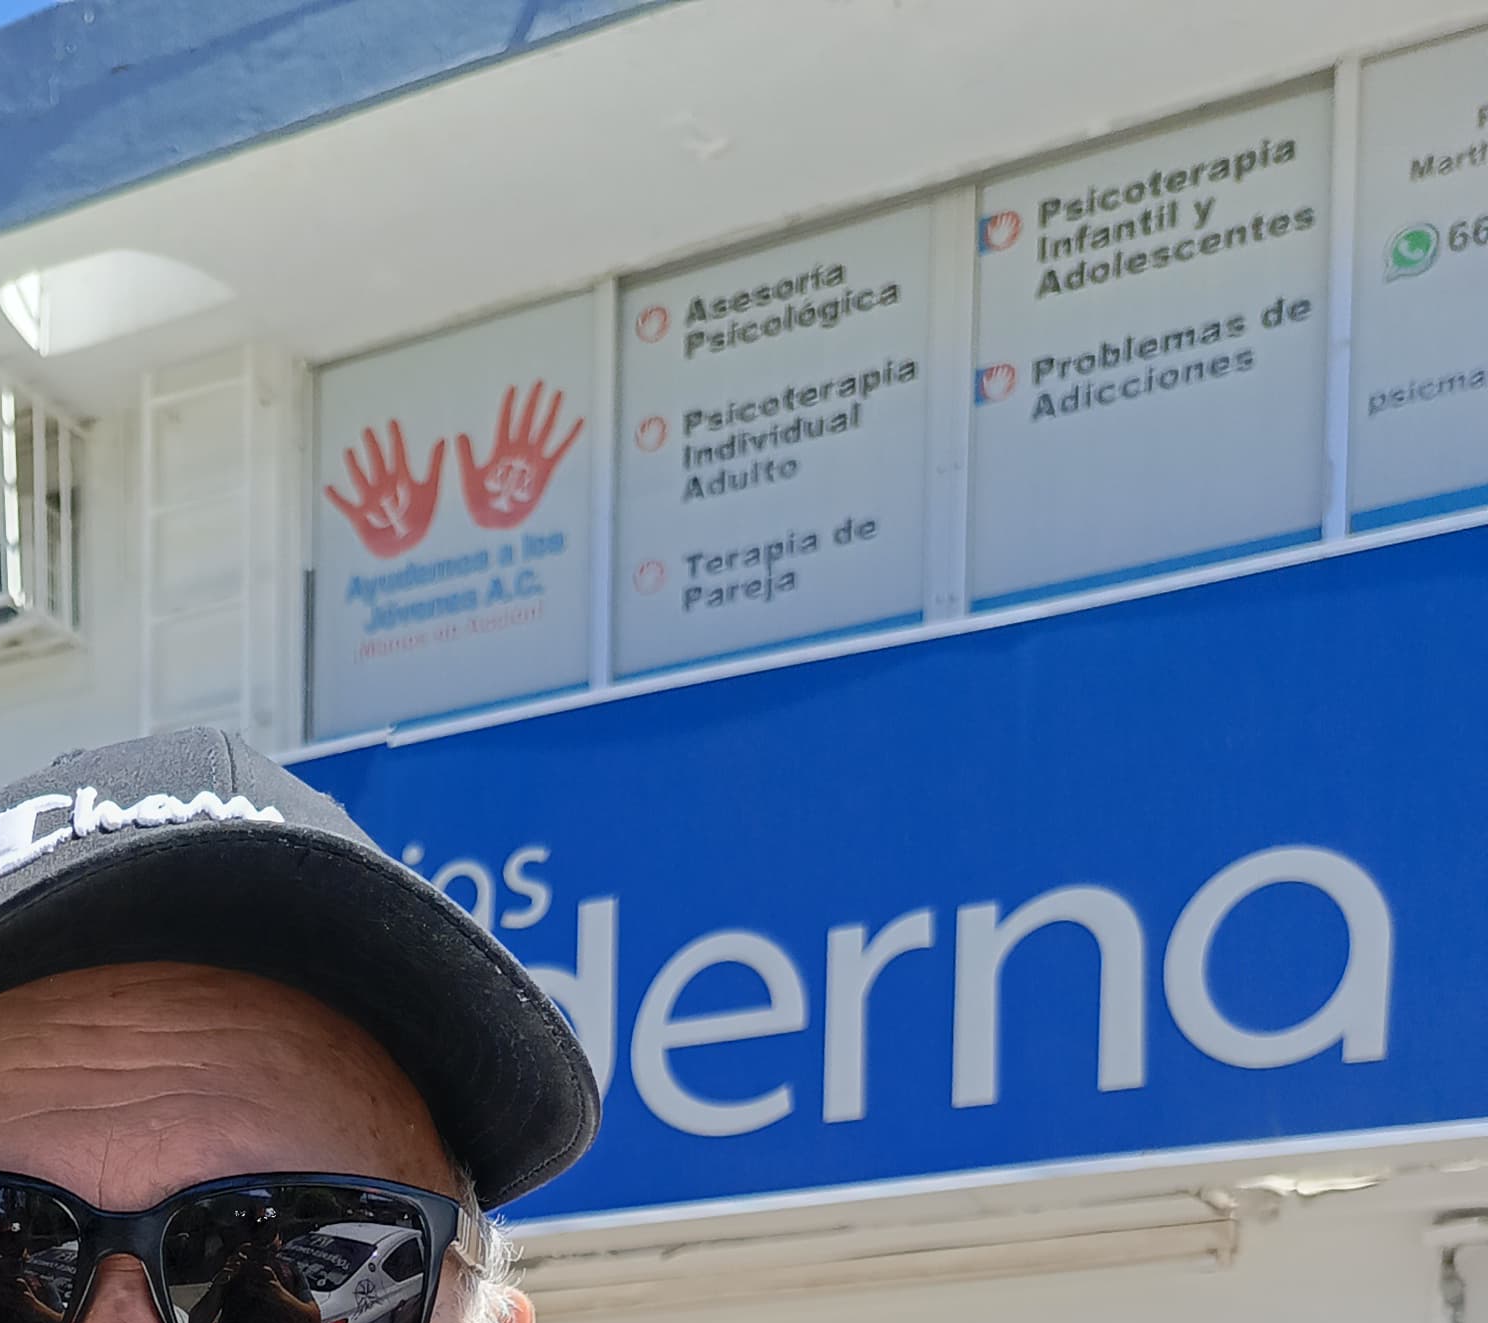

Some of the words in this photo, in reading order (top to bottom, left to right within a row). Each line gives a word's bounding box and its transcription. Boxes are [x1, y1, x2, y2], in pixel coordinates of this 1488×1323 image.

[1037, 136, 1297, 229] Psicoterapia
[1035, 206, 1317, 299] Adolescentes
[1037, 203, 1178, 262] Infantil
[1193, 196, 1216, 230] y
[1448, 215, 1488, 252] 66
[683, 281, 901, 360] Psicológica
[684, 262, 848, 327] Asesoría
[1030, 311, 1246, 385] Problemas
[1260, 296, 1312, 331] de
[683, 358, 920, 437] Psicoterapia
[1029, 347, 1256, 422] Adicciones
[1367, 368, 1488, 418] psicma
[682, 400, 862, 470] Individual
[681, 455, 799, 502] Adulto
[685, 532, 820, 579] Terapia
[833, 515, 880, 545] de
[681, 568, 798, 613] Pareja
[524, 843, 1393, 1138] derna
